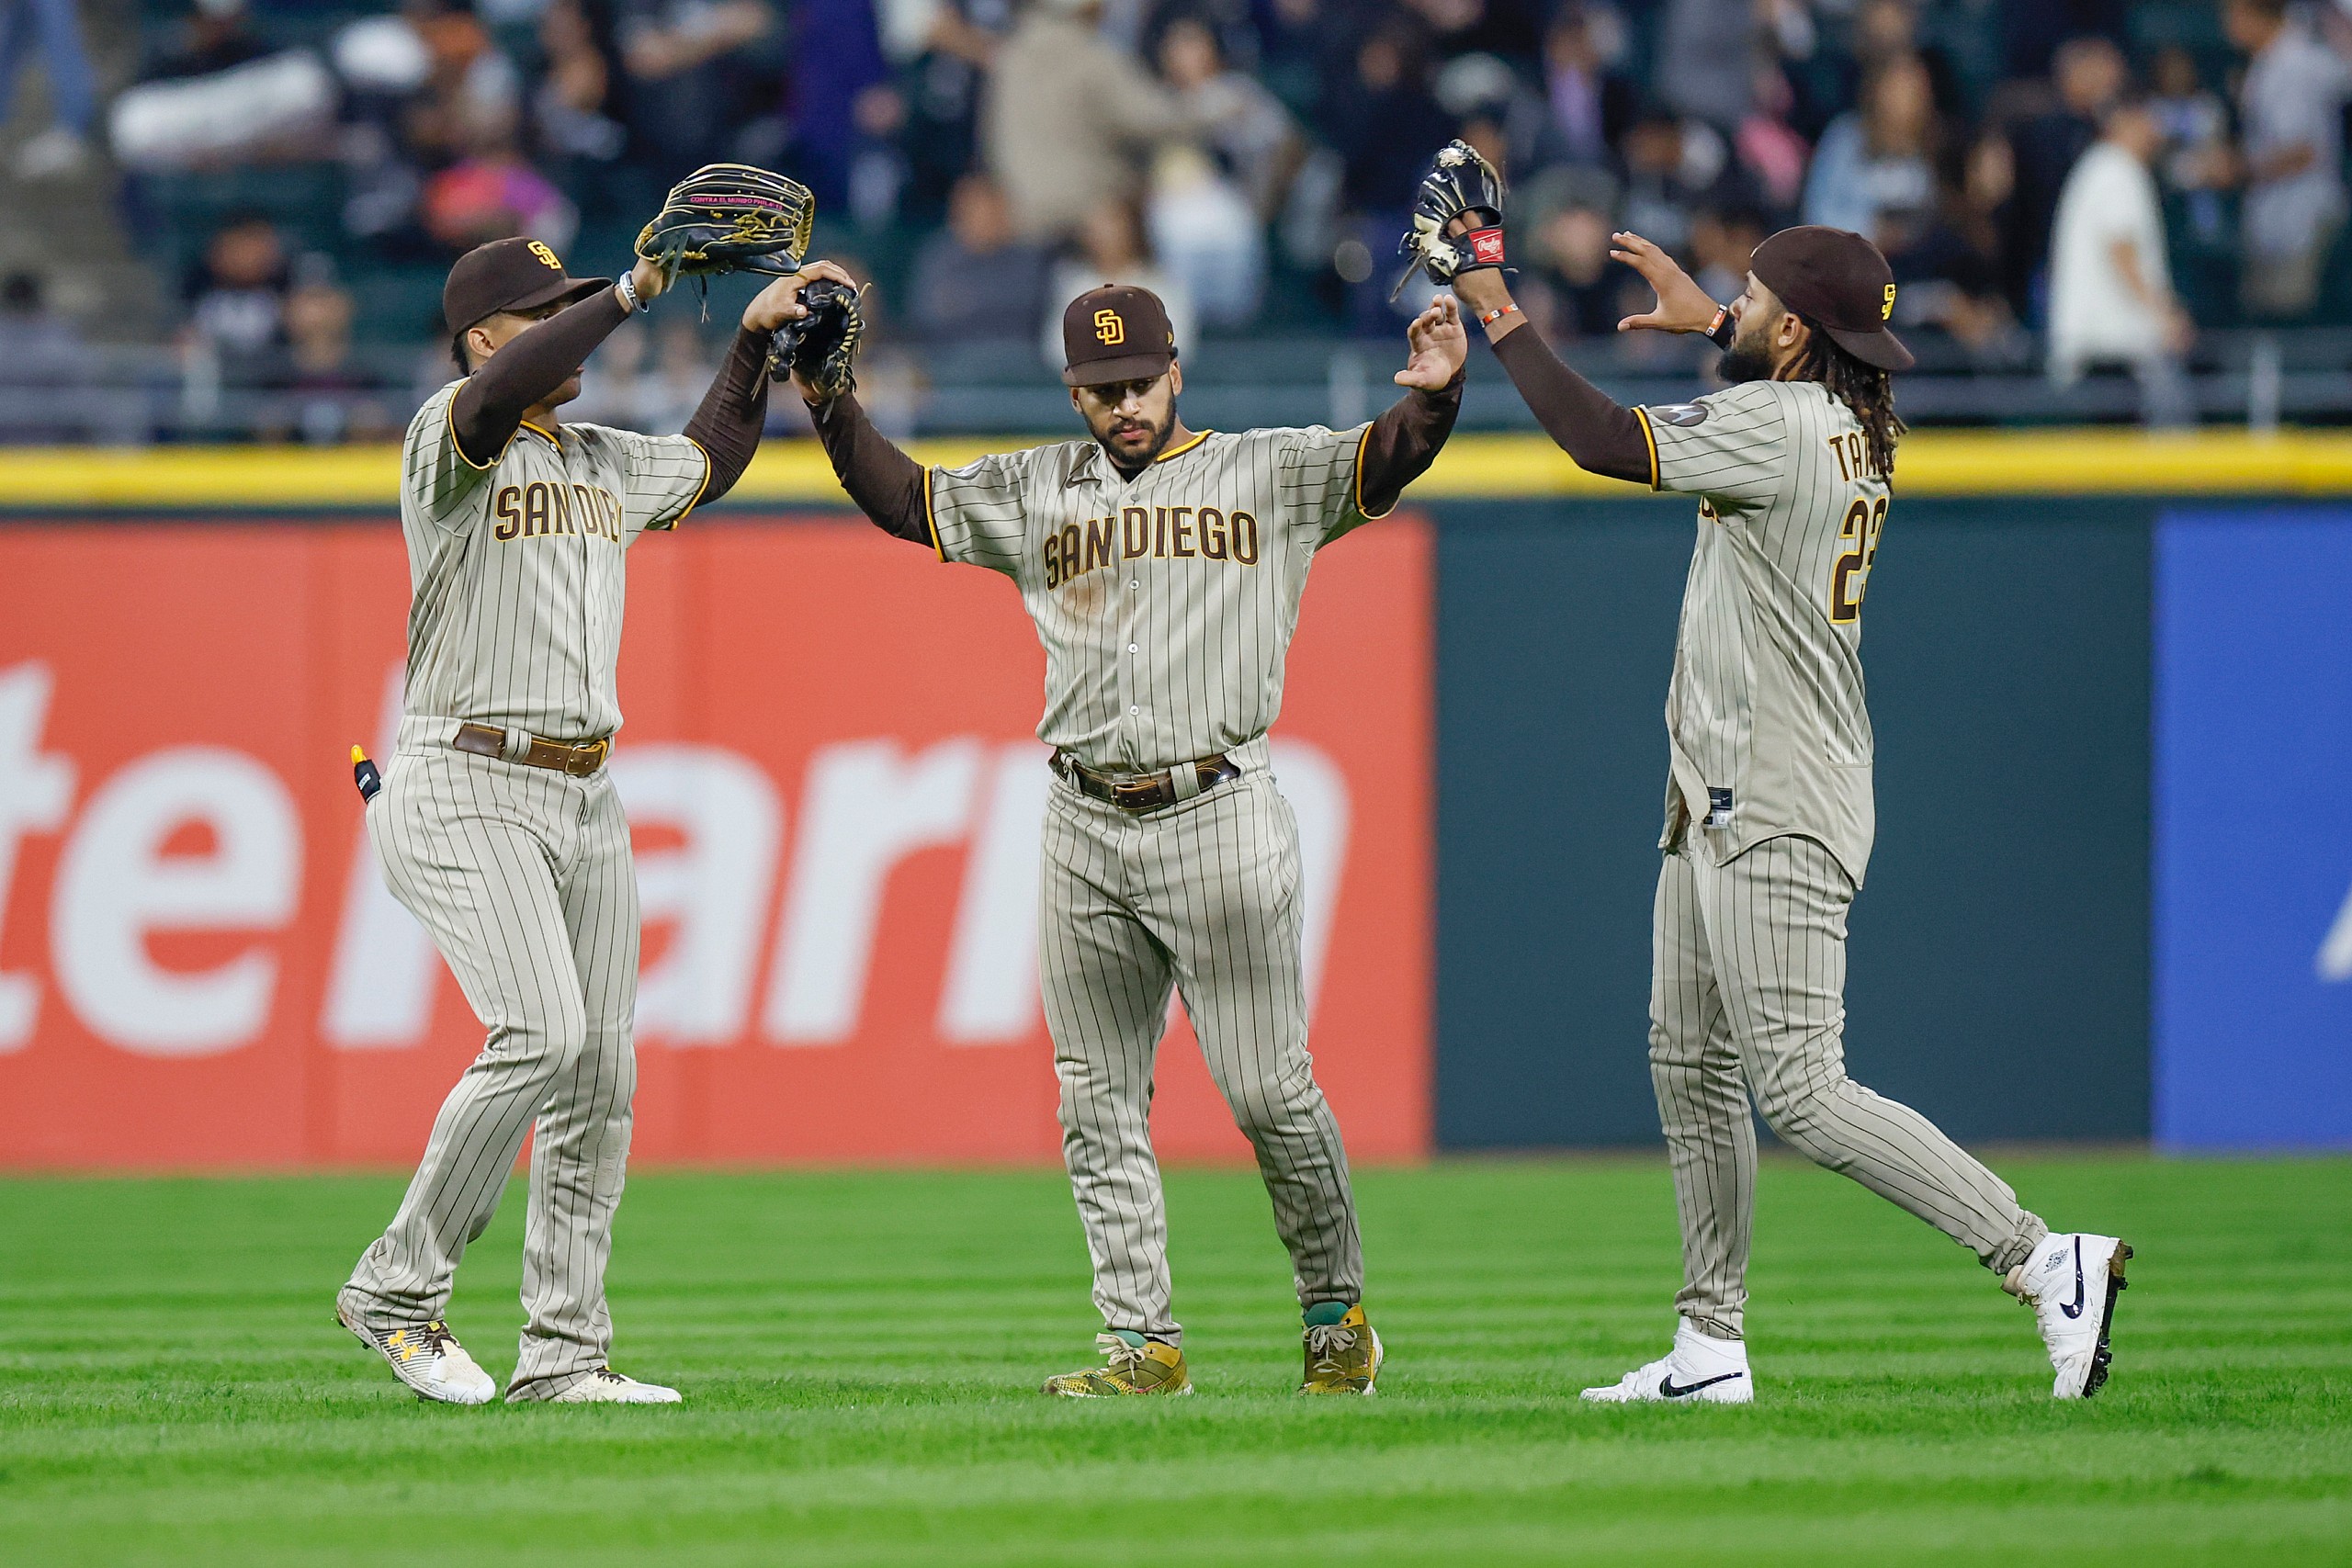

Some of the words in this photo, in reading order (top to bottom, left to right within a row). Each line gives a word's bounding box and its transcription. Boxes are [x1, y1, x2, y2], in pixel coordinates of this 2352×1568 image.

[526, 240, 562, 269] SD
[1093, 309, 1125, 345] SD
[1828, 428, 1886, 483] TAT
[494, 480, 577, 542] SAN
[571, 483, 622, 543] DIE
[1044, 516, 1116, 592] SAN
[1121, 506, 1259, 567] DIEGO
